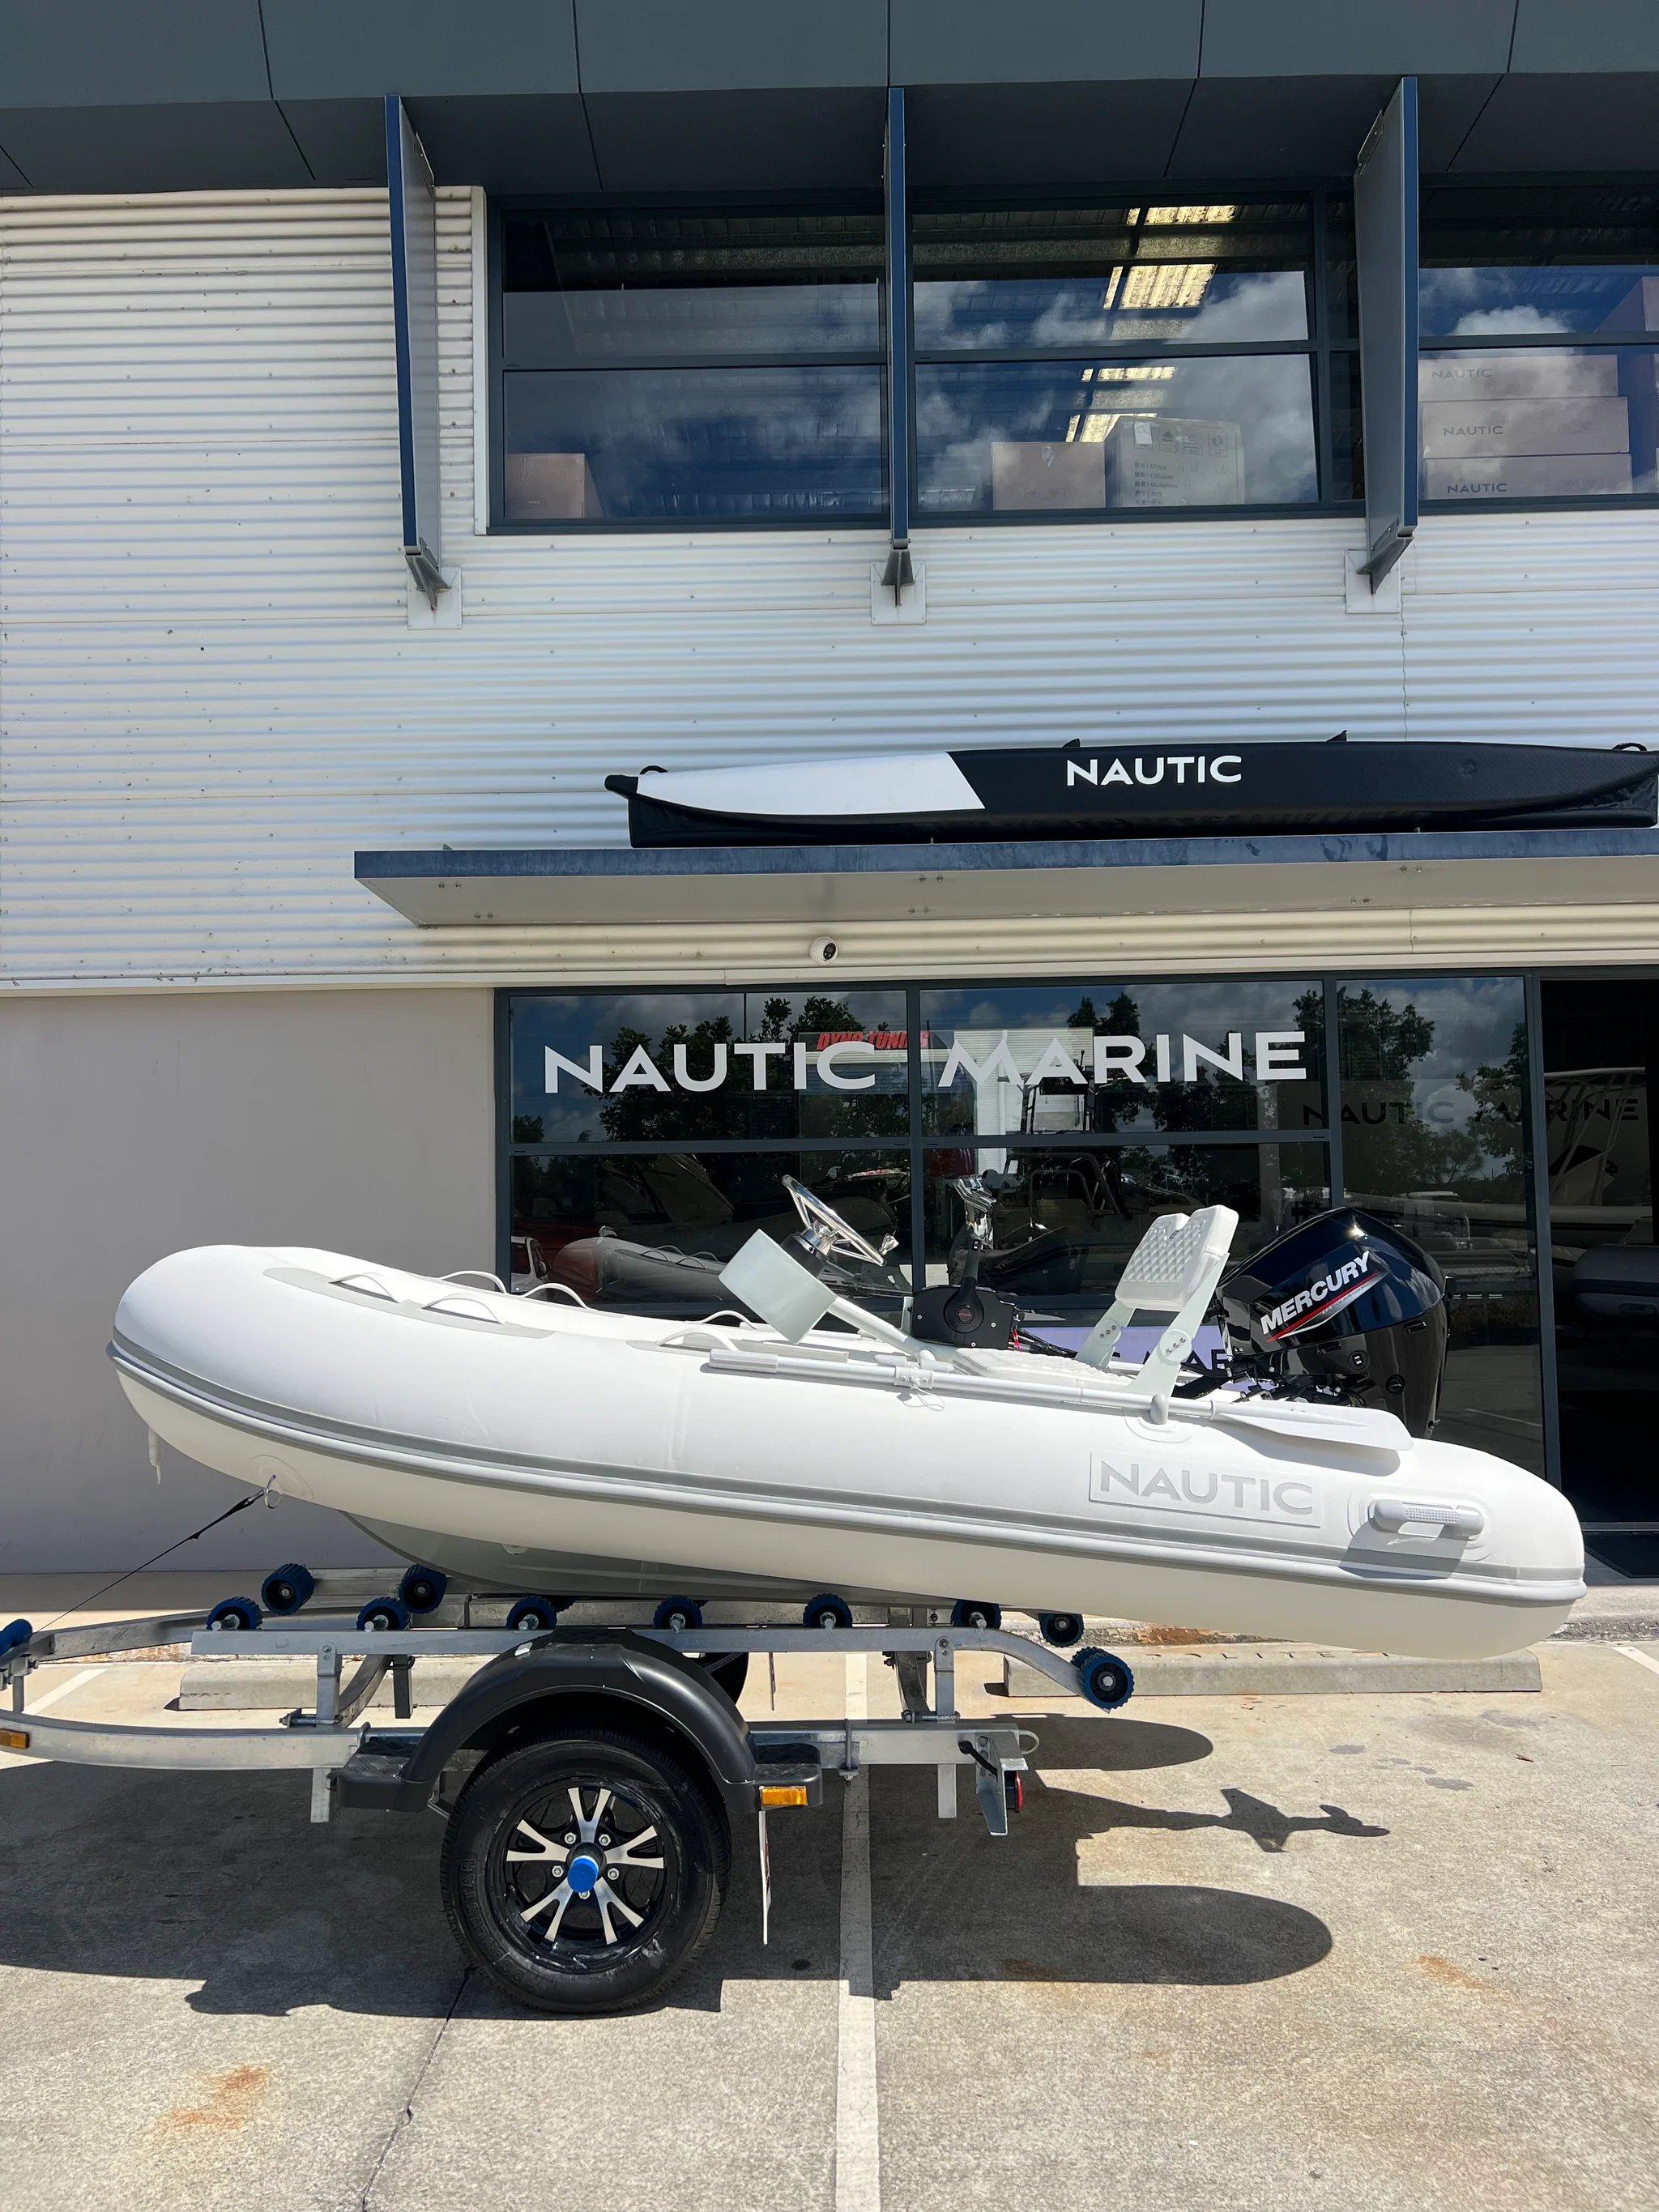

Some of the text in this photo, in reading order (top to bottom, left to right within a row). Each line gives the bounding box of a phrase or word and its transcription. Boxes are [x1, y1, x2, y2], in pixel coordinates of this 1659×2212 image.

[1431, 369, 1493, 379] NAUTIC
[1443, 425, 1504, 437] NAUTIC
[1447, 483, 1508, 494] NAUTIC
[1066, 755, 1242, 786] NAUTIC
[866, 1030, 931, 1050] TUNIG
[544, 1030, 1307, 1093] NAUTIC MARINE
[1474, 1098, 1640, 1124] MRINE
[1260, 1251, 1370, 1335] MERCURY
[1101, 1460, 1313, 1515] NAUTIC
